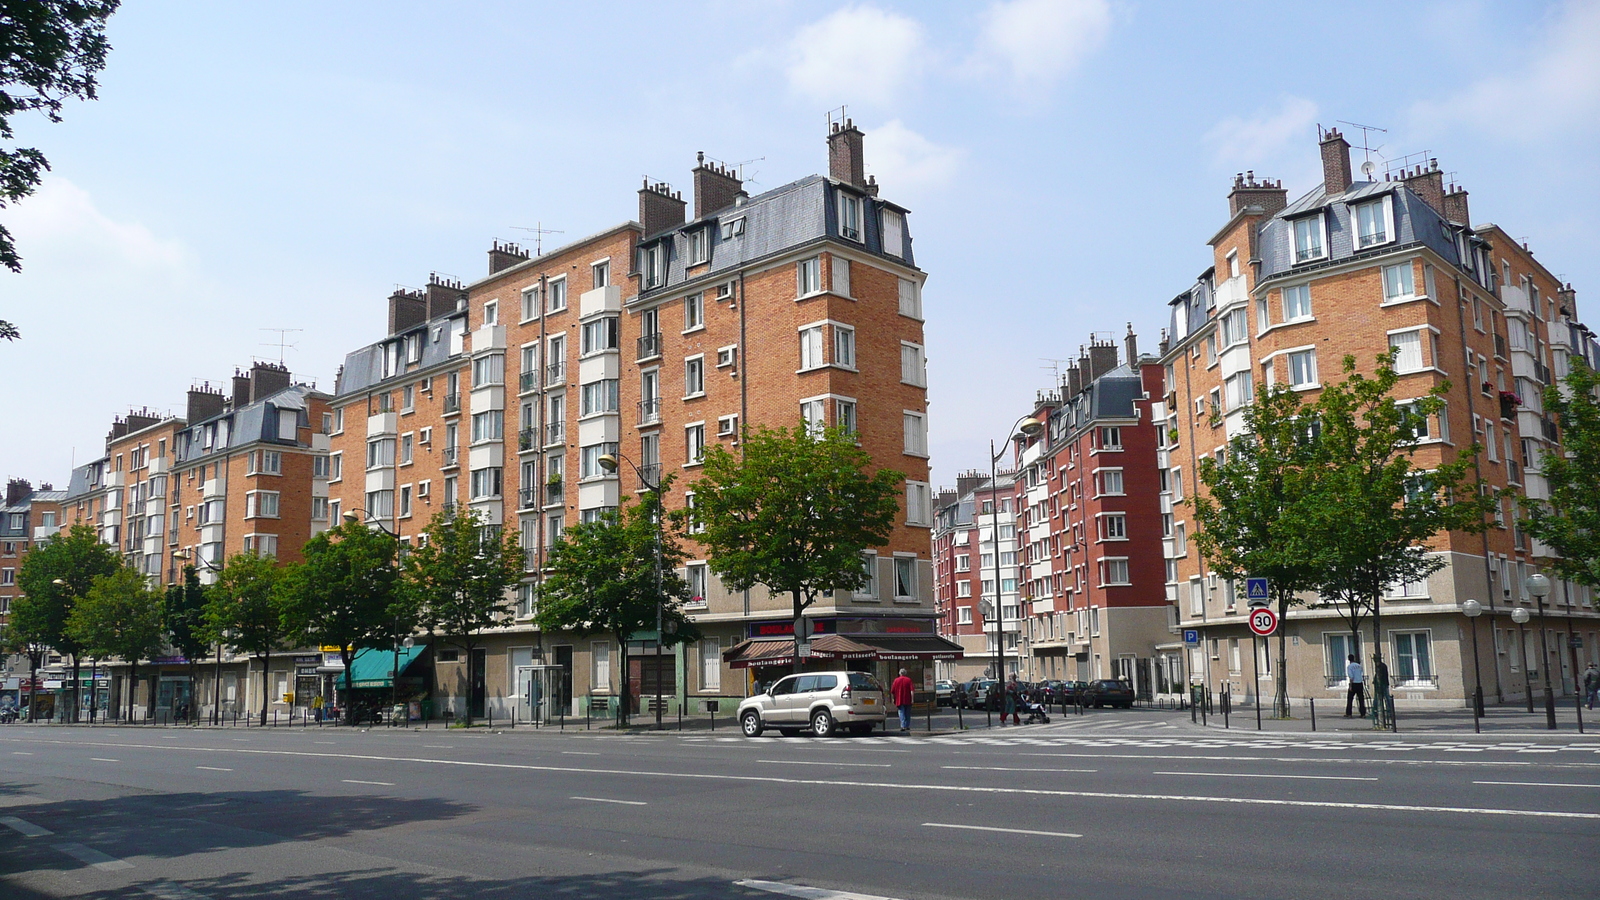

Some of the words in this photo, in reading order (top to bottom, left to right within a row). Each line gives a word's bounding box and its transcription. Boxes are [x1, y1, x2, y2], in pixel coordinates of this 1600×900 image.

[1255, 616, 1271, 627] 30
[759, 623, 824, 635] BOULANIE
[1188, 633, 1194, 641] P
[747, 658, 792, 667] boulangerie
